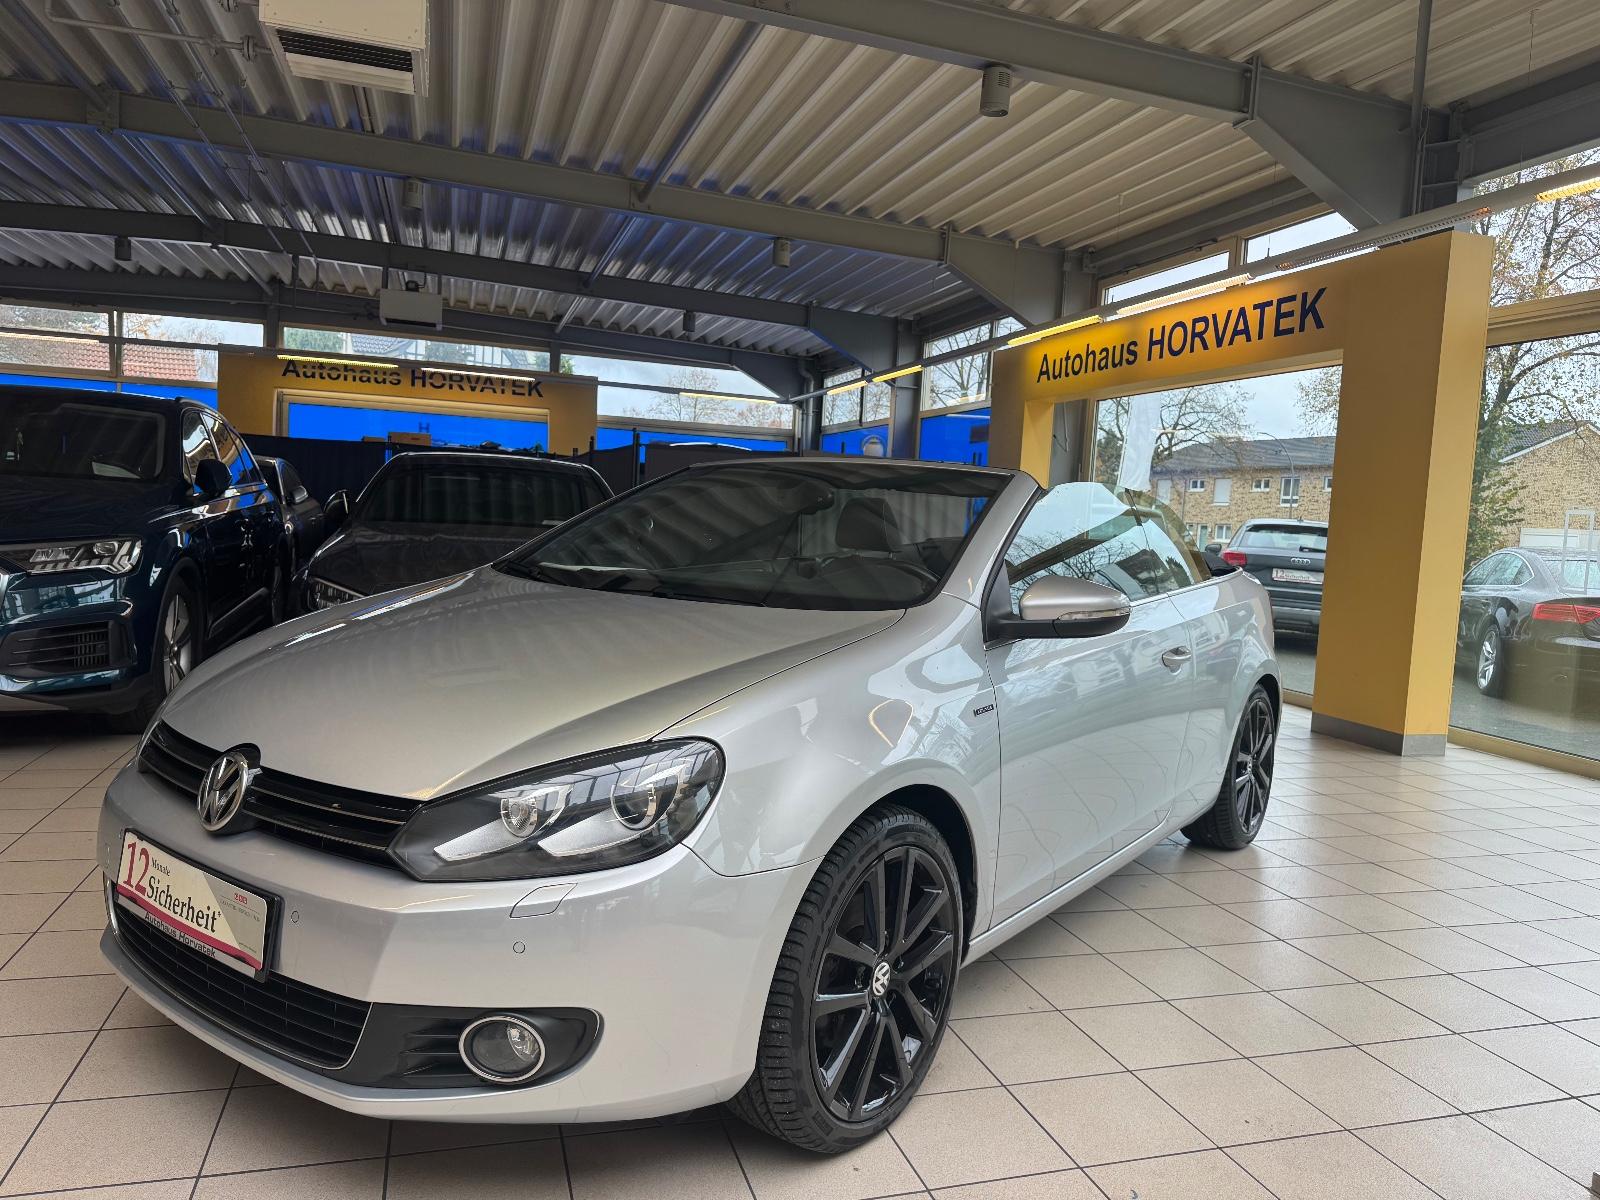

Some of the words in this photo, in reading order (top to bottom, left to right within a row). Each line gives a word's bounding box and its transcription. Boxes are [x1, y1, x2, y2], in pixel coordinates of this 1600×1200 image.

[1037, 339, 1138, 384] Autohaus
[1147, 286, 1328, 362] HORVATEK
[281, 359, 402, 386] Autohaus
[123, 841, 150, 897] 12
[144, 911, 177, 938] Autohaus
[178, 930, 216, 959] Horvatek
